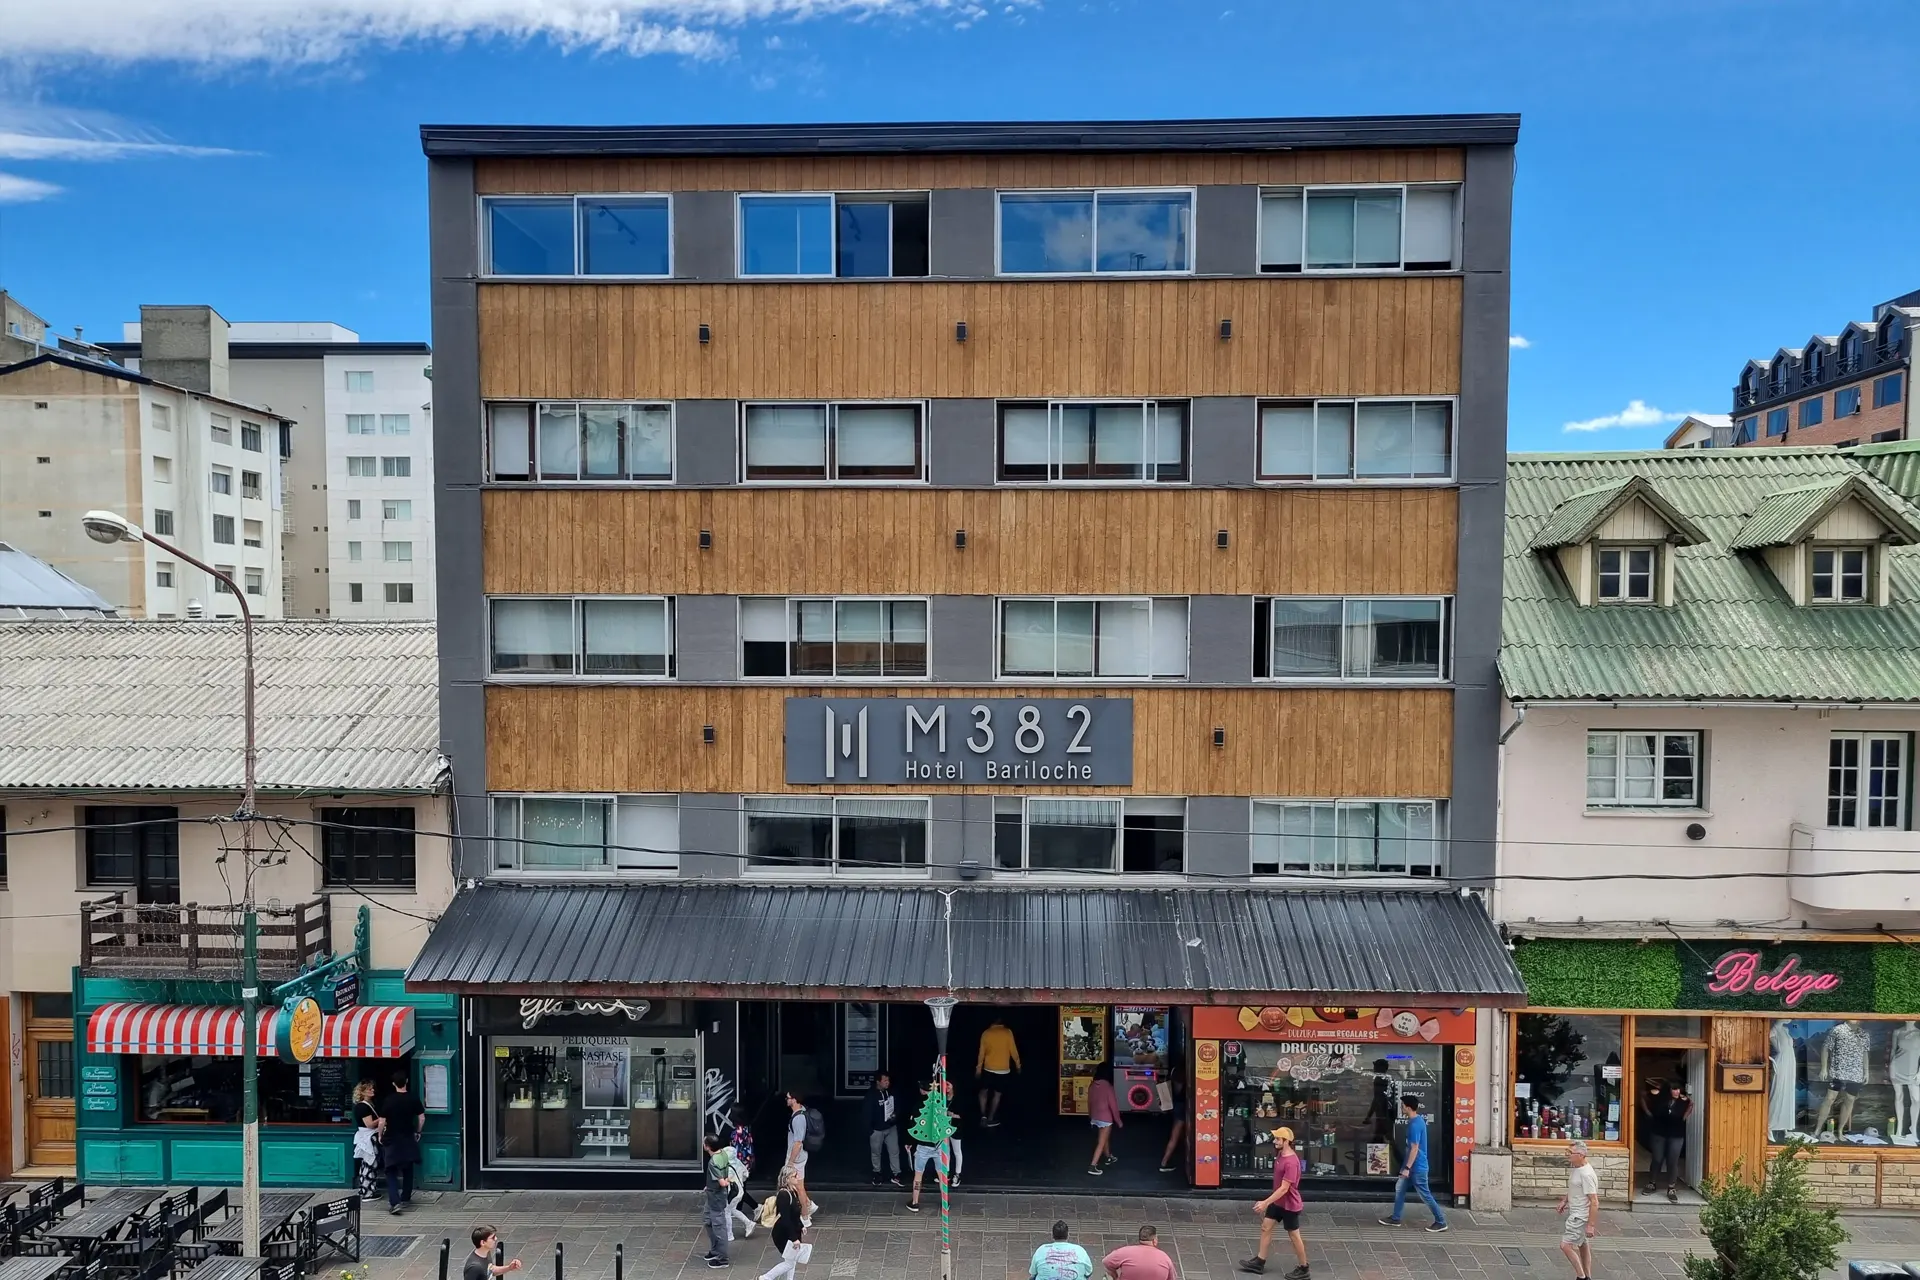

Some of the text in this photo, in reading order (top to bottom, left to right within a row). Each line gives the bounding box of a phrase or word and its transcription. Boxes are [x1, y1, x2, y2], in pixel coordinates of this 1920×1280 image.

[905, 704, 1092, 755] M382
[905, 760, 1093, 780] Hotel Bariloche
[1708, 952, 1840, 1004] Beleza
[1287, 1029, 1317, 1039] DULZURA
[1281, 1042, 1363, 1056] DRUGSTORE
[327, 1198, 349, 1208] BODEGA
[329, 1203, 347, 1211] DANTE
